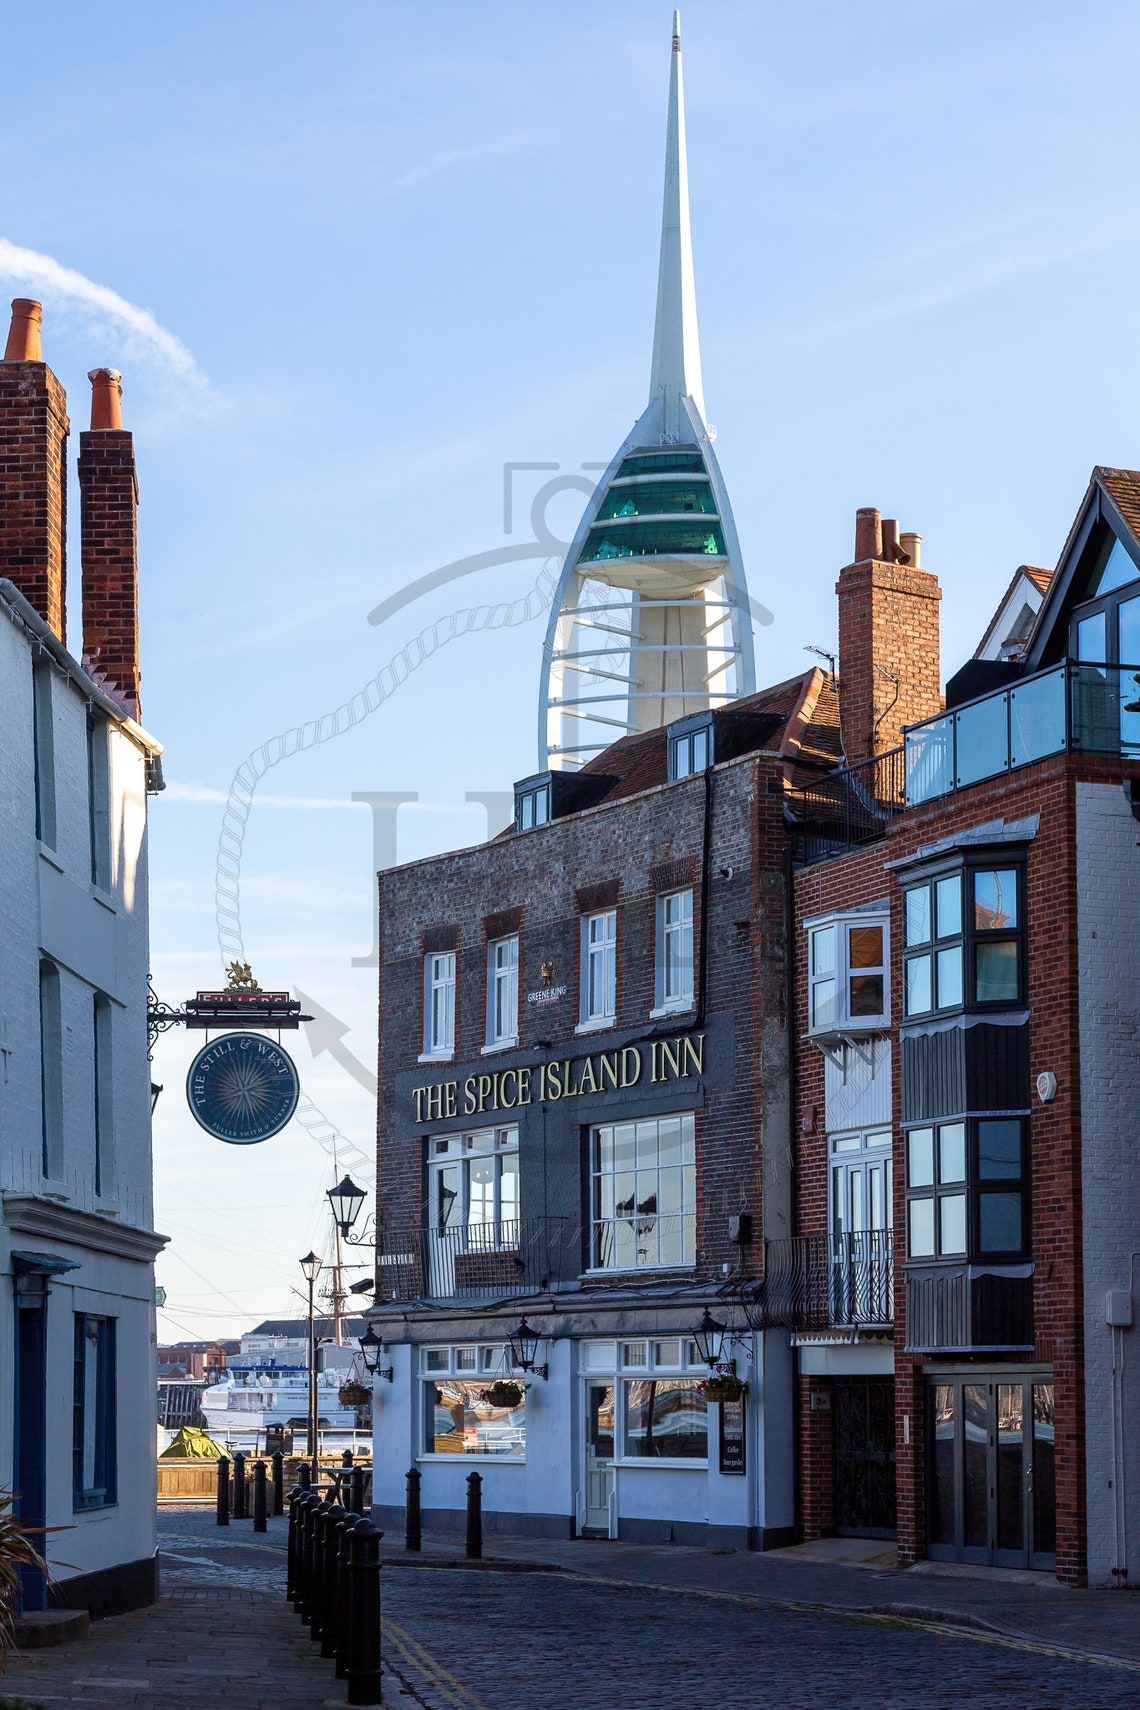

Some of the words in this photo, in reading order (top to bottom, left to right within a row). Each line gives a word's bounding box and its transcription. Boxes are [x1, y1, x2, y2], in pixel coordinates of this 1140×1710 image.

[527, 988, 551, 1002] GREENE
[550, 985, 567, 997] KING
[200, 1041, 235, 1072] STILL
[239, 1038, 252, 1050] &
[256, 1043, 290, 1075] WEST
[194, 1074, 207, 1107] THE
[412, 1081, 458, 1124] THE
[463, 1068, 532, 1116] SPICE
[538, 1046, 641, 1103] ISLAND
[650, 1034, 706, 1083] INN
